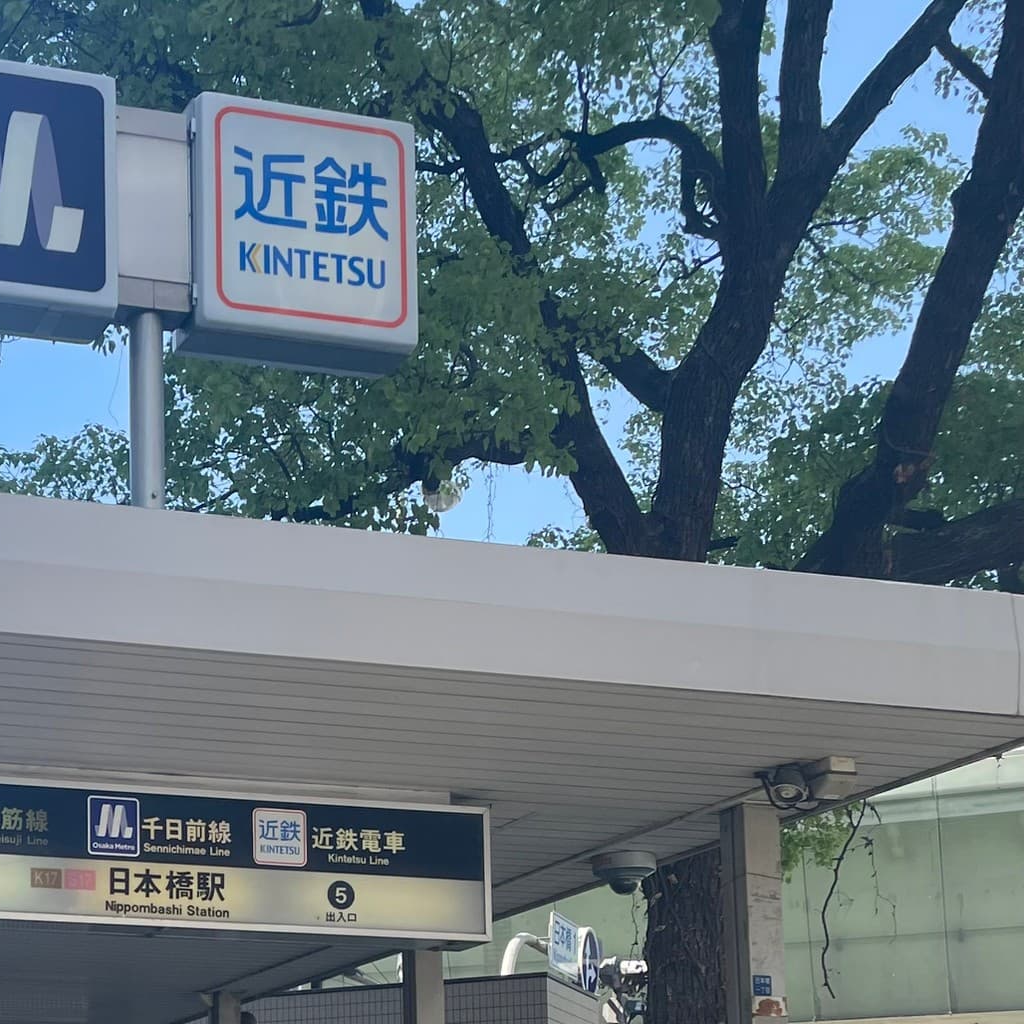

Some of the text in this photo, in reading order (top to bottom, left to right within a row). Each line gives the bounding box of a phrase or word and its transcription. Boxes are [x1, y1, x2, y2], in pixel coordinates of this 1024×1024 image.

[233, 145, 389, 240] 近鉄
[239, 241, 386, 290] KINTETSU
[141, 816, 232, 844] 千日前線
[258, 819, 302, 842] 近鉄
[27, 836, 49, 846] Line
[92, 841, 136, 851] Osaka Metro
[311, 826, 406, 854] 近鉄電車
[143, 842, 231, 857] Sennichimae Line
[260, 844, 301, 856] KINTETSU
[328, 853, 390, 866] Kintetsu Line
[34, 869, 58, 886] K17
[109, 867, 226, 902] 日本橋駅
[335, 887, 347, 904] 5
[105, 900, 230, 919] Nippombashi Station
[326, 911, 357, 923] 出入口
